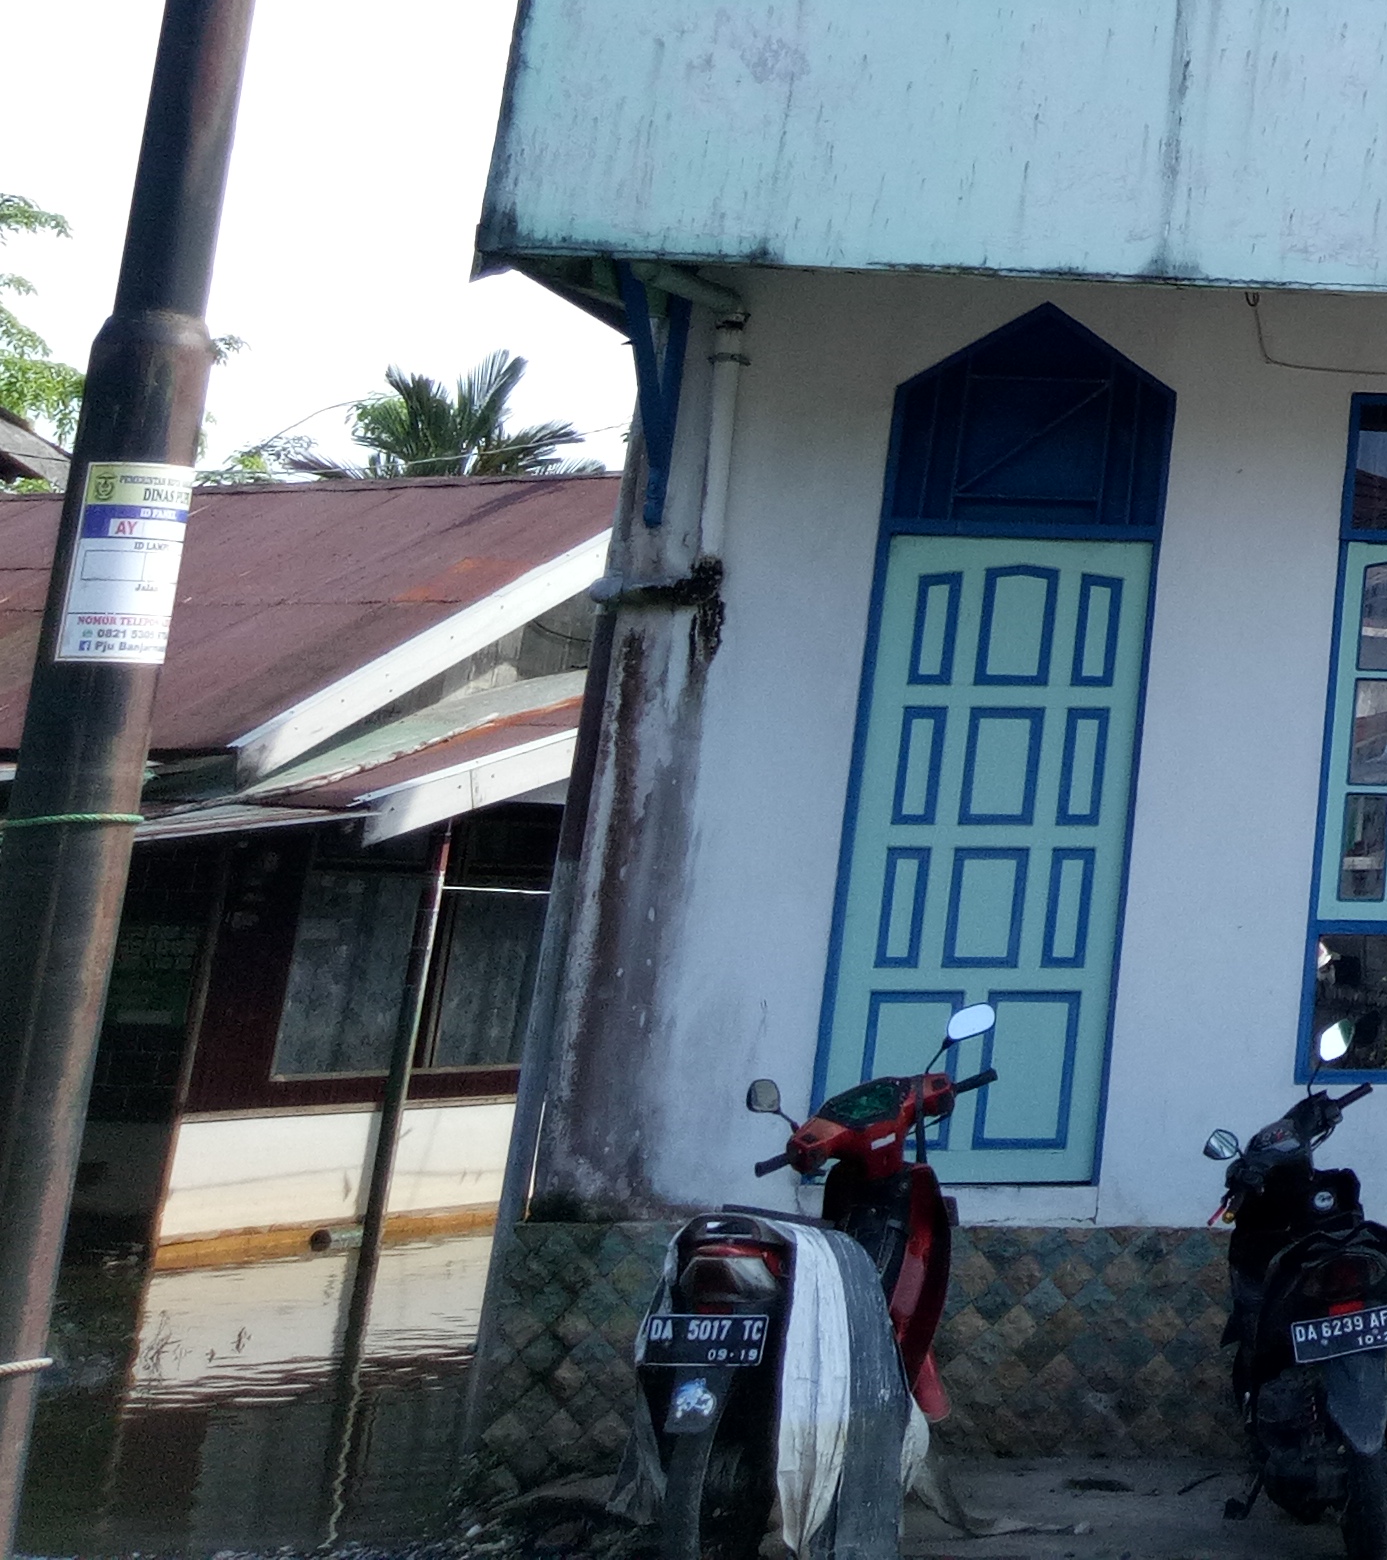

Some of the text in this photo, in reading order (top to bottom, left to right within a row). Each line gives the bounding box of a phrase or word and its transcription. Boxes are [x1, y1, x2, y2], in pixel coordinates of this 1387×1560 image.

[143, 488, 175, 503] DINAS
[140, 508, 151, 518] ID
[115, 520, 138, 536] AY
[133, 541, 144, 550] ID
[77, 616, 117, 626] NOMOR
[97, 628, 127, 639] 0821
[94, 640, 115, 653] Pju
[649, 1318, 764, 1341] DA 5017 TC
[1295, 1323, 1317, 1343] DA
[1321, 1315, 1364, 1338] 6239
